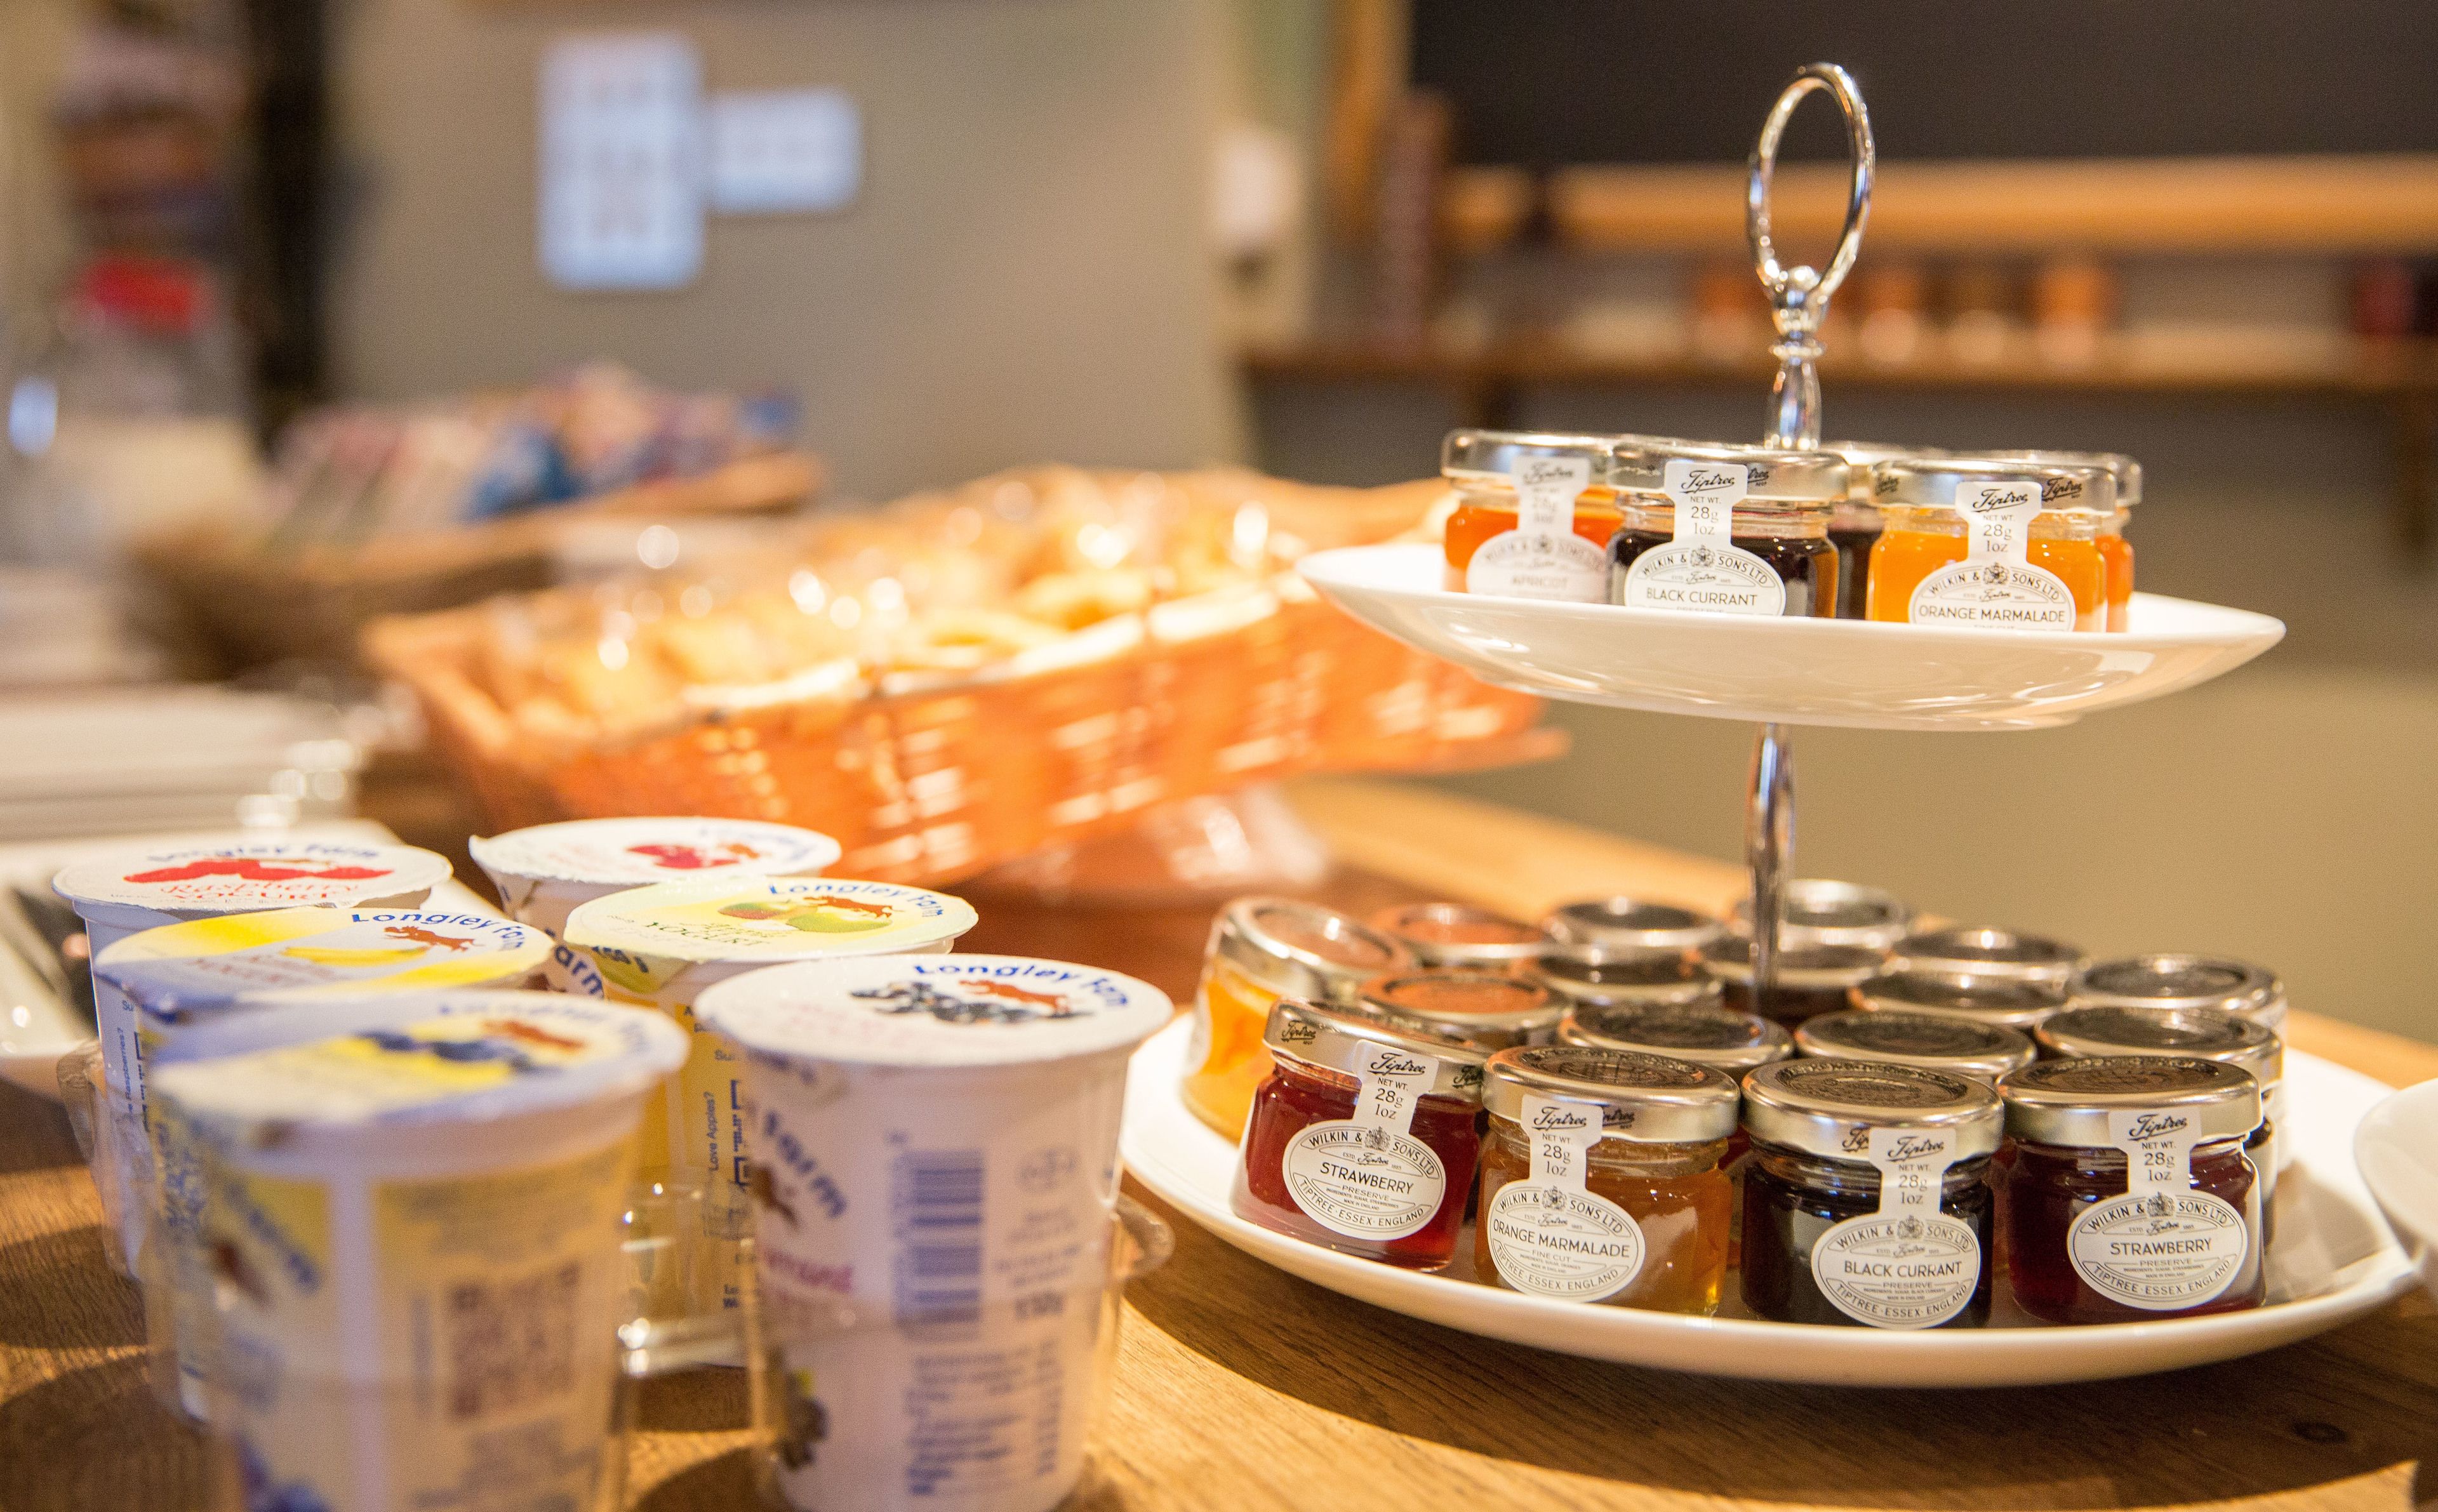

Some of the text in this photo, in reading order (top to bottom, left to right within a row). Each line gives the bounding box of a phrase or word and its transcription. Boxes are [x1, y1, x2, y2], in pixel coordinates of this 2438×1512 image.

[1679, 470, 1735, 494] Tiptree
[1971, 489, 2028, 512] Tiptree
[1691, 507, 1719, 523] 28g
[1694, 523, 1715, 535] 1oz
[1983, 524, 2012, 540] 28g
[1986, 541, 2008, 552] 1oz
[1642, 554, 1768, 585] WILKIN & SONS LTD
[1929, 572, 2060, 601] WILKIN & SONS LTD
[1646, 587, 1758, 606] BLACK CURRANT
[1919, 605, 2065, 623] ORANGE MARMALADE
[768, 883, 910, 897] Longley
[351, 913, 500, 931] Longley
[914, 964, 1081, 983] Longley
[1367, 1052, 1426, 1076] Tiptree
[1377, 1077, 1393, 1087] NET
[1375, 1088, 1403, 1108] 28g
[1376, 1104, 1396, 1120] 1oz
[1532, 1106, 1587, 1131] Tiptree
[703, 1091, 719, 1172] Love Apples?
[2128, 1113, 2187, 1141] Tiptree
[1309, 1132, 1435, 1174] WILKIN & SONS LTD
[1543, 1144, 1571, 1164] 28g
[1886, 1136, 1944, 1162] Tiptree
[1547, 1160, 1567, 1177] 1oz
[2145, 1151, 2175, 1169] 28g
[1320, 1162, 1413, 1195] STRAWBERRY
[1899, 1174, 1928, 1191] 28g
[2149, 1169, 2171, 1181] 1oz
[1300, 1179, 1424, 1226] TIPTREE ESSEX ENGLAND
[1342, 1185, 1390, 1201] PRESERVE
[1902, 1191, 1923, 1204] 1oz
[1500, 1193, 1623, 1234] WILKIN & SONS LTD
[2088, 1202, 2228, 1230] WILKIN & SONS LTD
[1493, 1219, 1630, 1257] ORANGE MARMALADE
[1837, 1225, 1969, 1250] WILKIN & SONS LTD
[2110, 1238, 2212, 1255] STRAWBERRY
[1532, 1249, 1571, 1263] FINE CUT
[2140, 1258, 2192, 1267] PRESERVE
[1496, 1245, 1618, 1290] TIPTREE ESSEX ENGLAND
[1844, 1260, 1962, 1278] BLACK CURRANT
[2095, 1260, 2230, 1296] TIPTREE ESSEX ENGLAND
[1837, 1283, 1967, 1318] TIPTREE ESSEX ENGLAND
